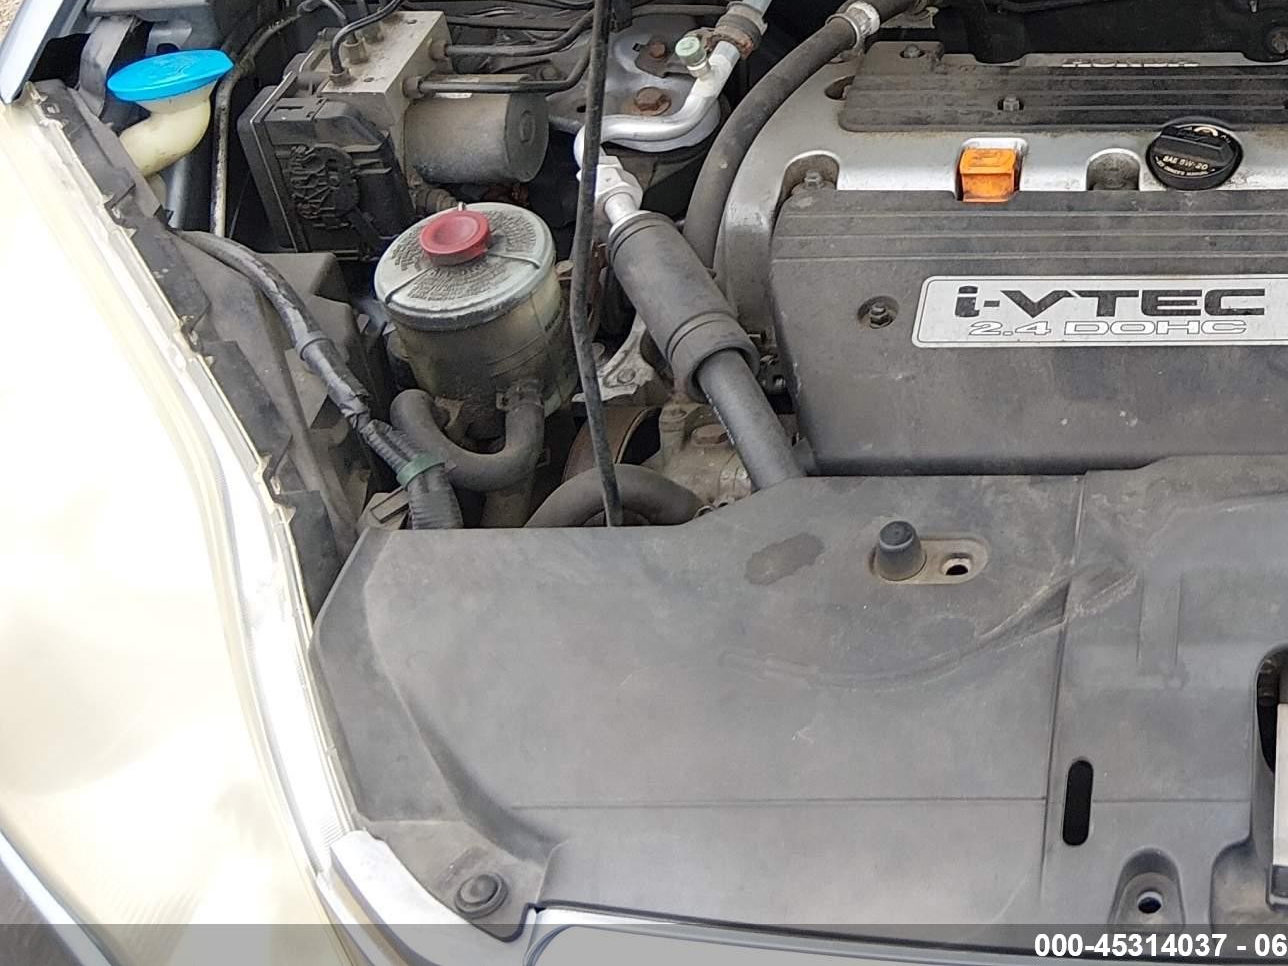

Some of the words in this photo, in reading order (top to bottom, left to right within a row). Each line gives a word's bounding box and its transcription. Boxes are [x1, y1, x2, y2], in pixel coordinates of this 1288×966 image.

[954, 285, 1266, 318] i-VTEC
[967, 320, 1052, 337] 2.4
[1063, 320, 1247, 336] DOHC
